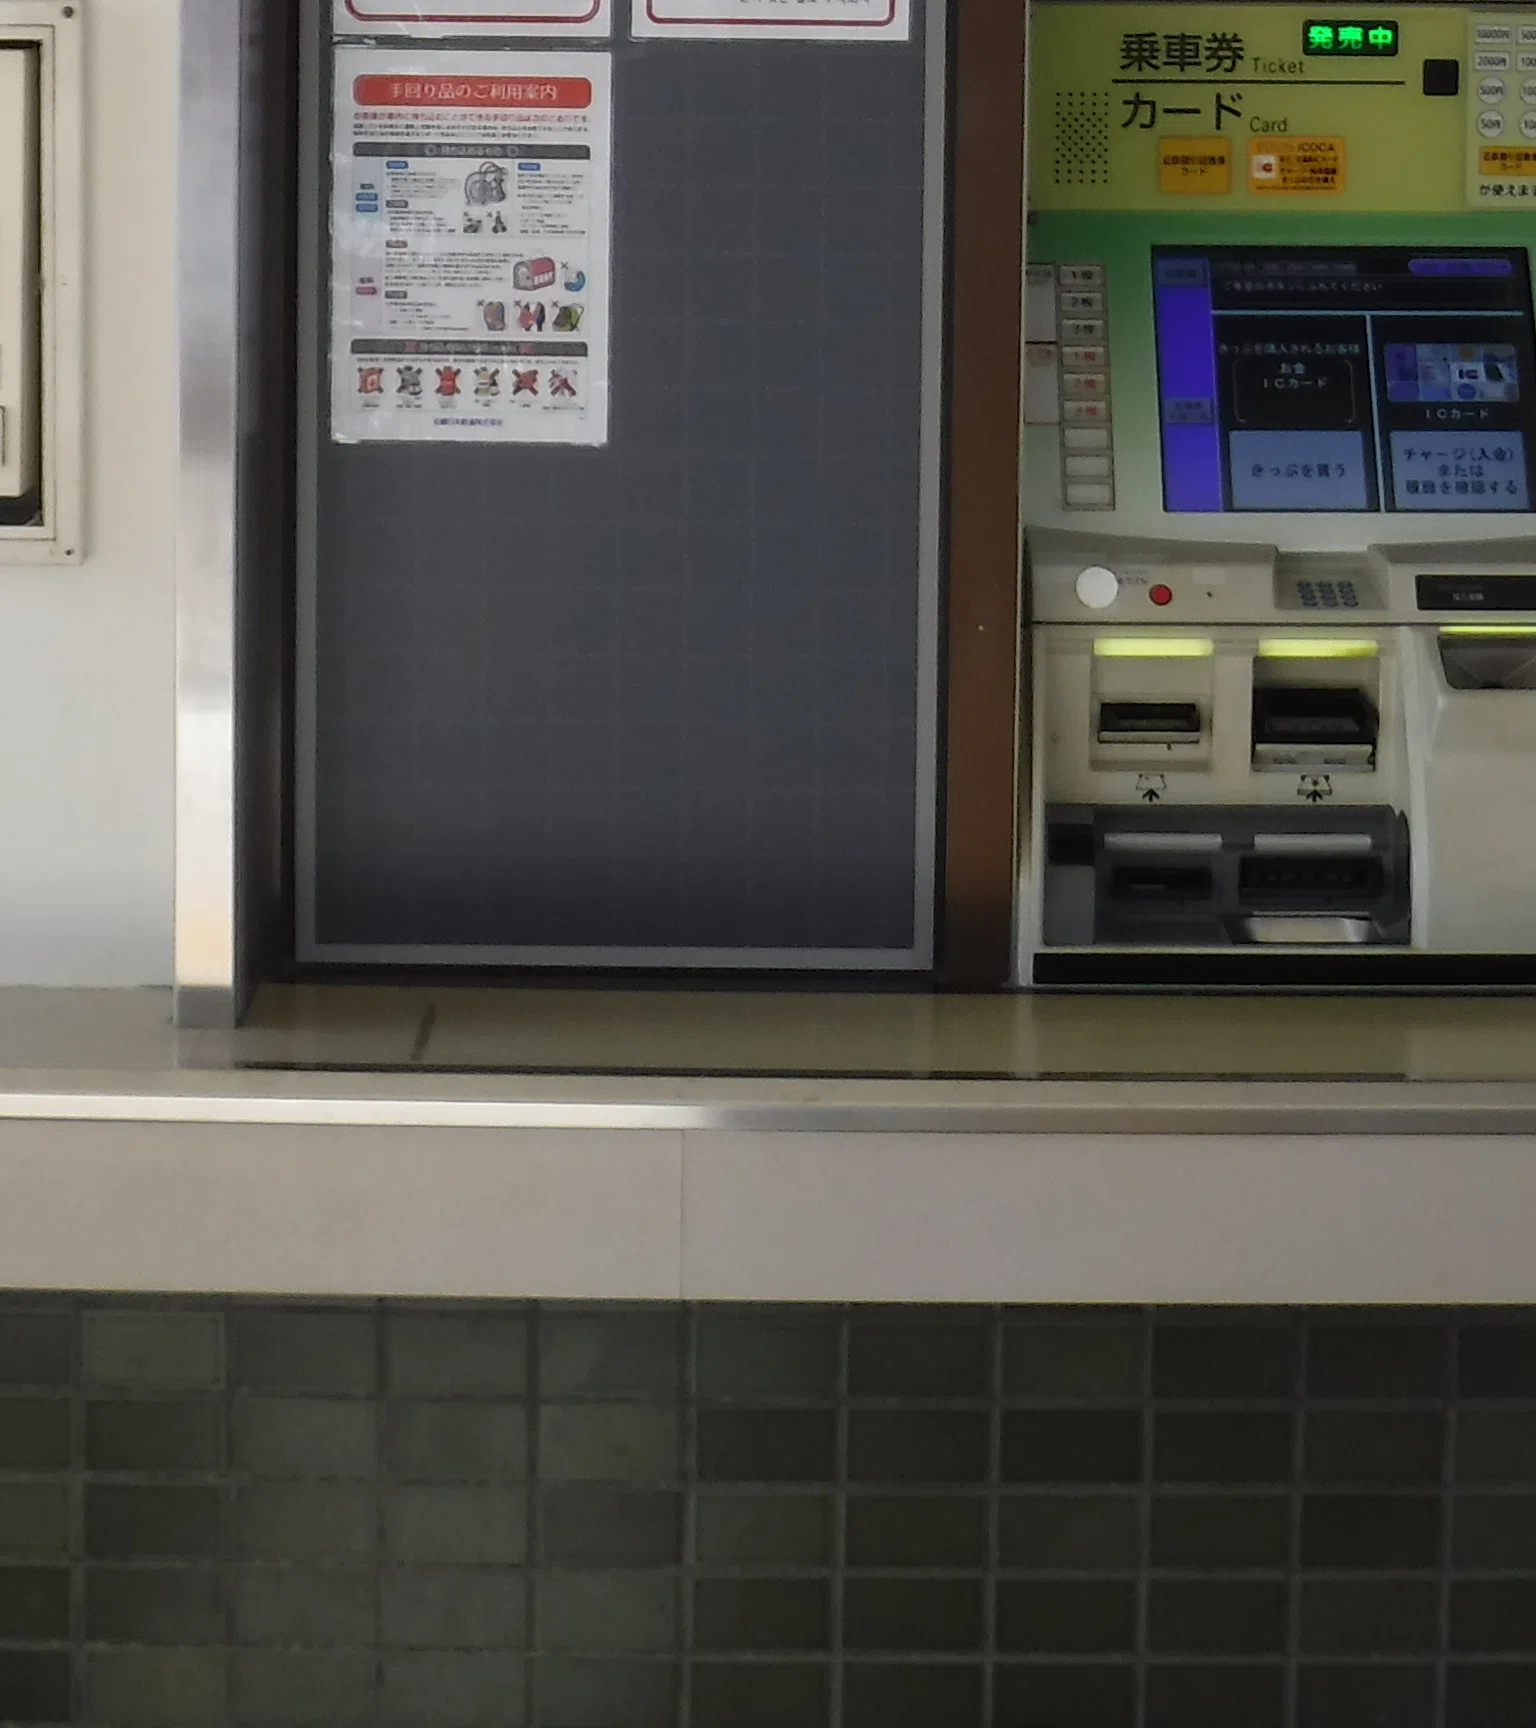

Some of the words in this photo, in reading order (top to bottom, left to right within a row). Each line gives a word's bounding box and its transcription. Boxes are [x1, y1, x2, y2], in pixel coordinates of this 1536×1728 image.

[1120, 32, 1244, 72] 乗車券
[1252, 58, 1304, 74] Ticket
[1308, 26, 1393, 50] 発売中
[391, 84, 557, 100] 手回り品のご利用案内
[1122, 92, 1242, 130] カード
[1250, 116, 1288, 132] Card
